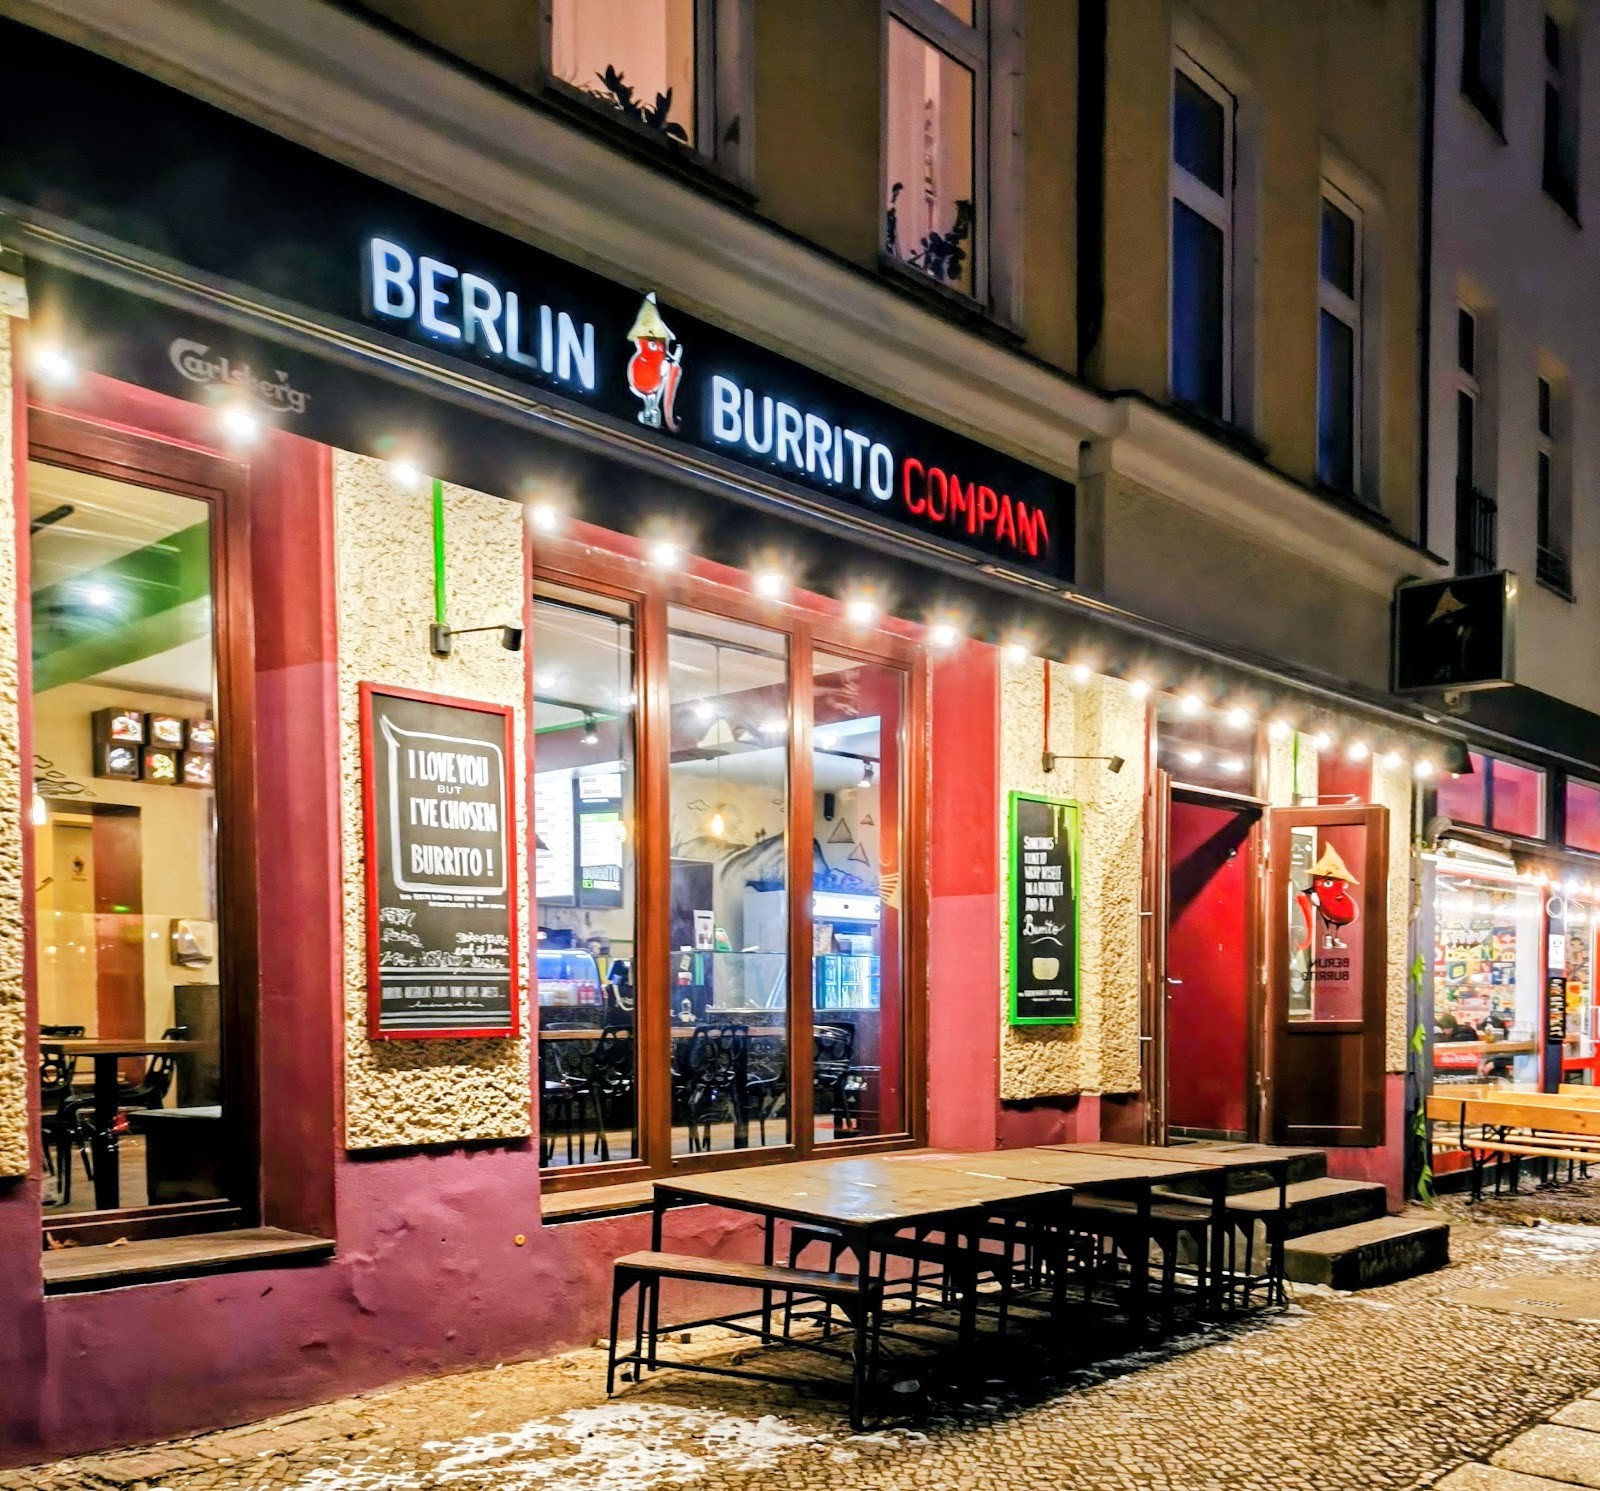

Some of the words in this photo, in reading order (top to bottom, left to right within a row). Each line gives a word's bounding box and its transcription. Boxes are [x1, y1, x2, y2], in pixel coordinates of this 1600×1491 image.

[370, 237, 595, 390] BERLIN
[712, 375, 894, 501] BURRITO
[408, 749, 416, 779] I
[418, 750, 457, 783] LOVE
[456, 753, 489, 787] YOU
[437, 784, 463, 795] BUT
[409, 797, 440, 828] I'VE
[440, 800, 498, 832] CHOSEN
